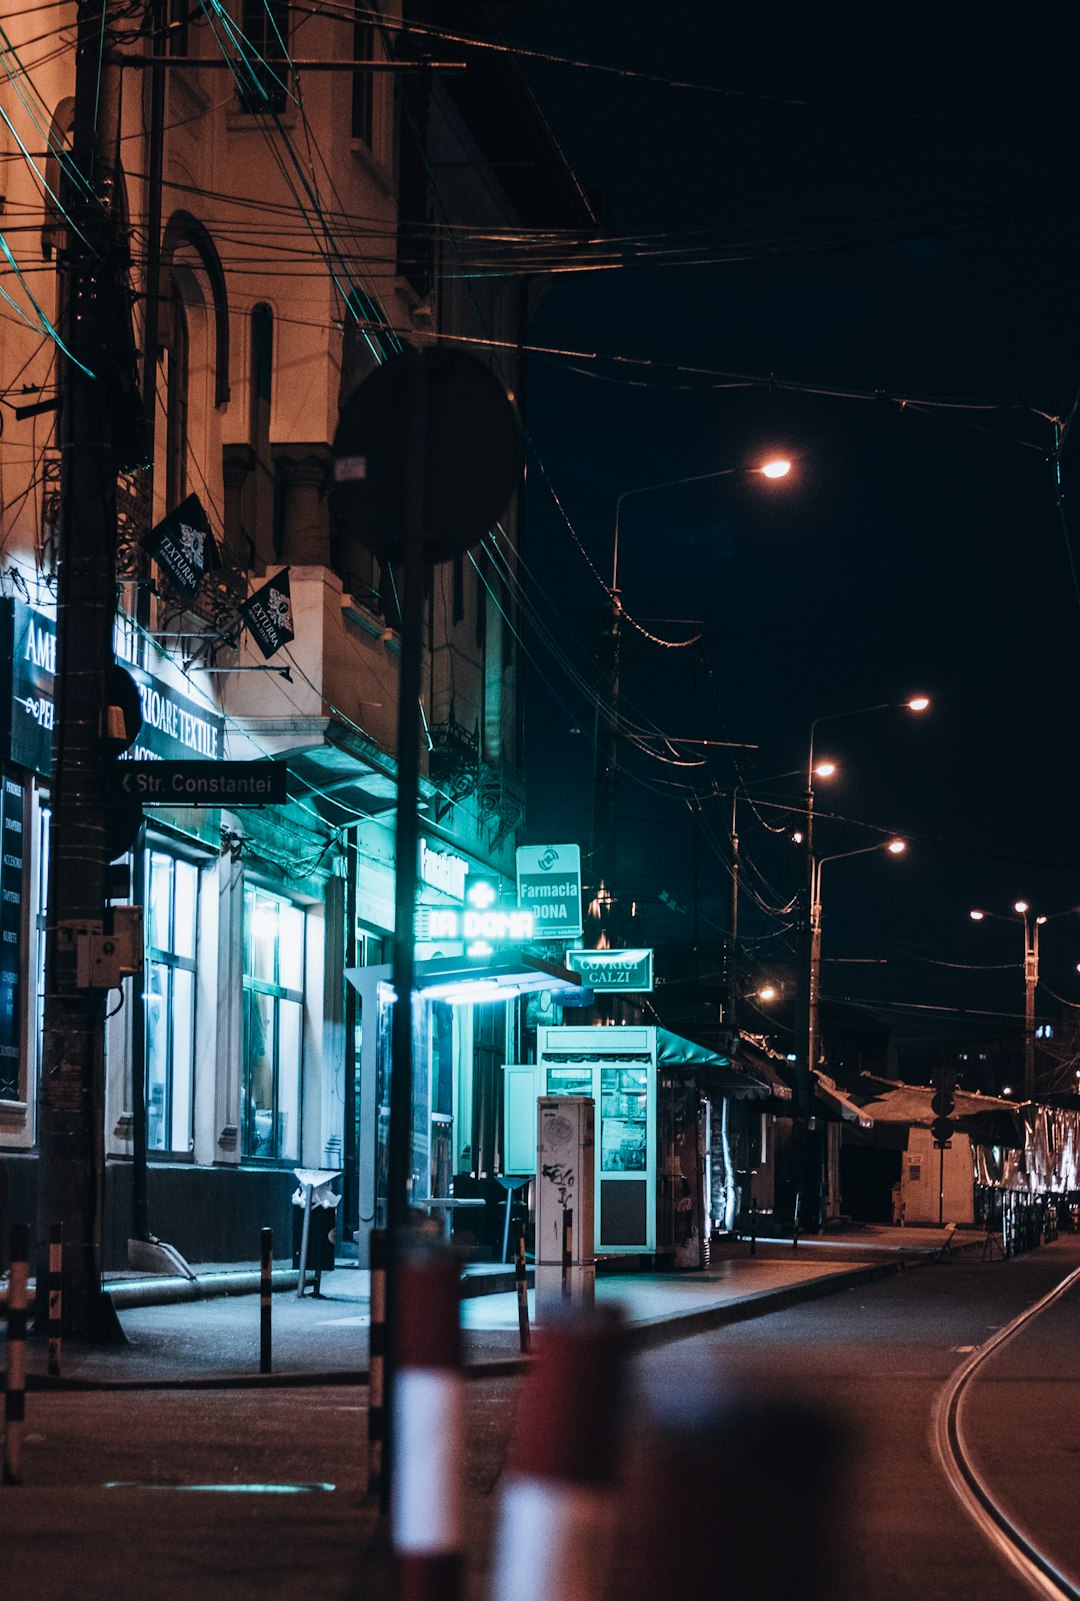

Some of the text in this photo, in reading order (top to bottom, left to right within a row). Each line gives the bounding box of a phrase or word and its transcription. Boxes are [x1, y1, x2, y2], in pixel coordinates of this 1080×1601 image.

[160, 535, 197, 589] TEXTURRA
[179, 710, 218, 760] TEXTILE
[136, 773, 271, 792] Str. Constantei
[520, 882, 578, 898] Farmacia
[532, 904, 568, 919] DONA
[464, 911, 533, 938] DONA
[580, 958, 639, 970] COVRIGI
[589, 971, 630, 983] CALZI
